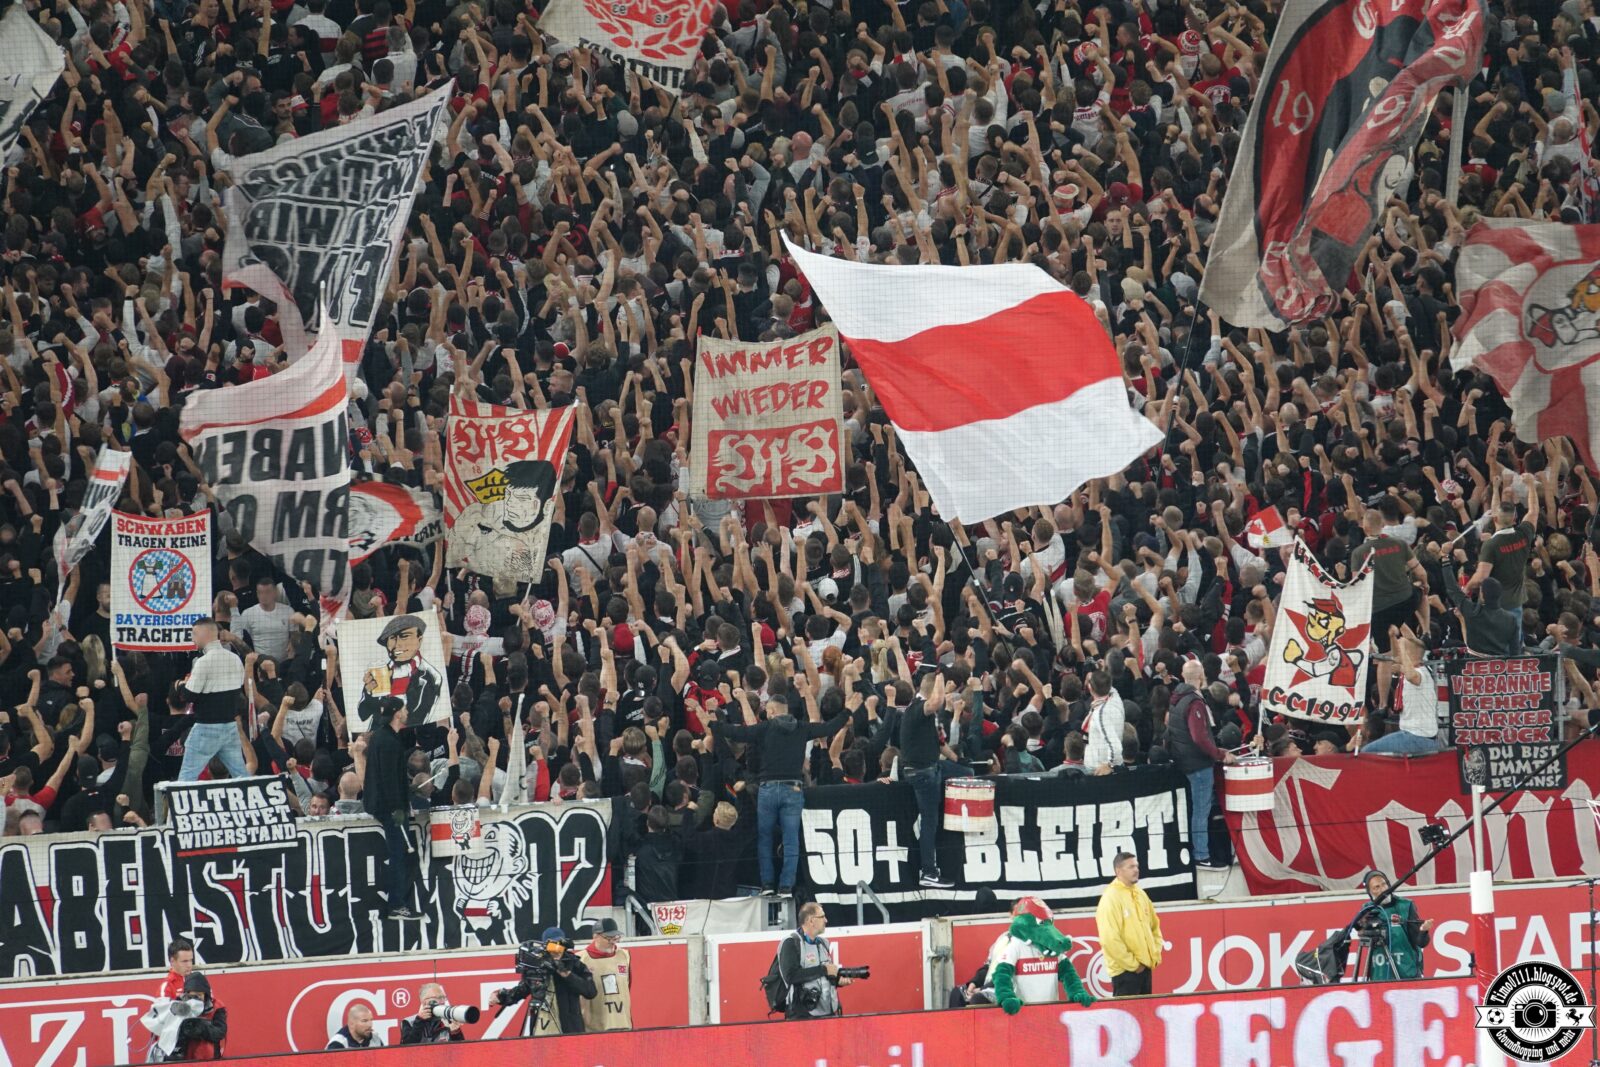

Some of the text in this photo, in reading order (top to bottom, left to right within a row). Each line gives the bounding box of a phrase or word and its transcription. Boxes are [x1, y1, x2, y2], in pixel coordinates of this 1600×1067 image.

[700, 336, 834, 379] IMMER
[711, 380, 830, 421] WIEDER
[116, 517, 207, 536] SCHWABEN
[117, 534, 207, 549] TRAGEN KEINE
[1461, 658, 1541, 676] JEDER
[1450, 671, 1552, 696] VERBANNTE
[1461, 692, 1544, 711] KEHRT
[1452, 709, 1553, 728] STÄRKER
[1455, 725, 1552, 745] ZURÜCK
[1488, 743, 1561, 761] DU BIST
[171, 780, 288, 815] ULTRAS
[175, 804, 291, 833] BEDEUTET
[176, 822, 297, 850] WIDERSTAND
[604, 1001, 624, 1014] TV
